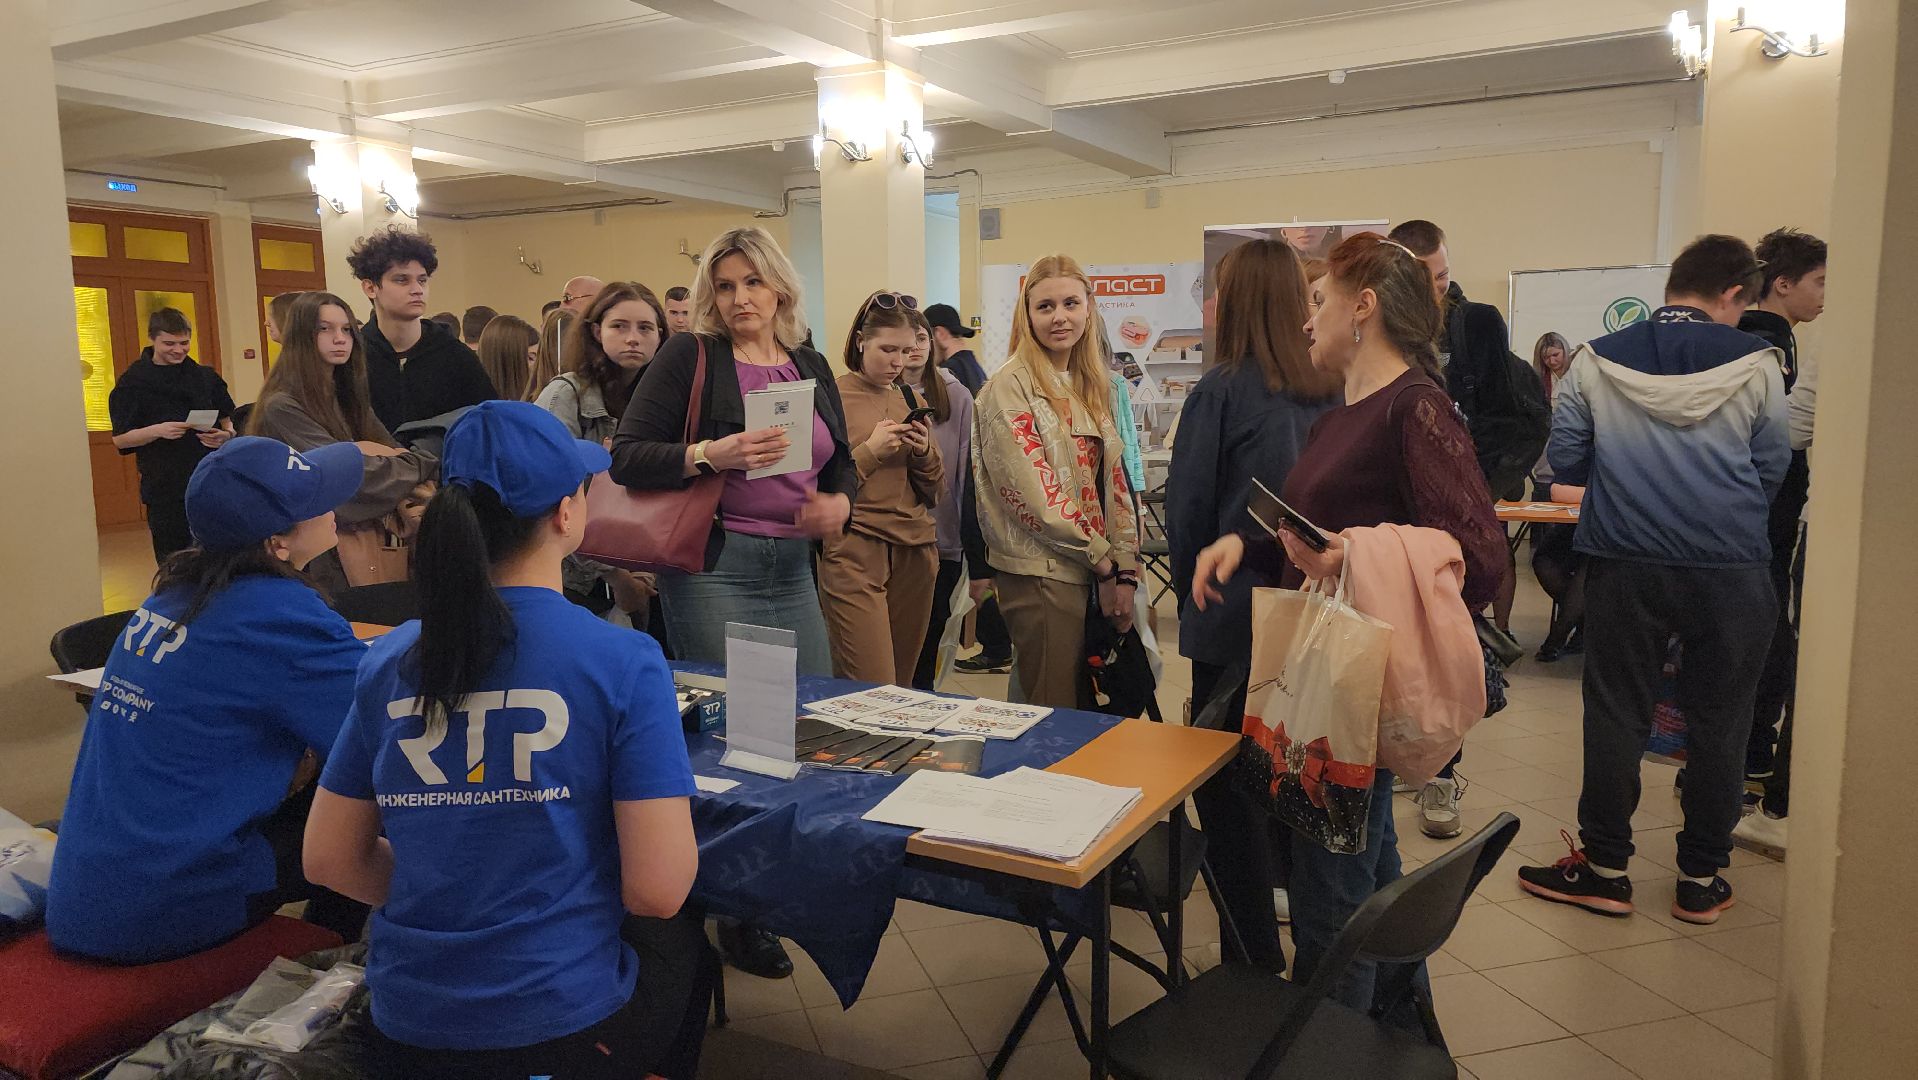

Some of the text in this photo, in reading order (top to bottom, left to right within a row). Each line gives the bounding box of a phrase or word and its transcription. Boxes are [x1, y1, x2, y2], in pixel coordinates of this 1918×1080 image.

[123, 607, 188, 664] RTP
[112, 686, 155, 712] COMPANY
[387, 689, 569, 785] RTP
[376, 785, 571, 808] ИНЖЕНЕРНАЯ САНТЕХНИКА
